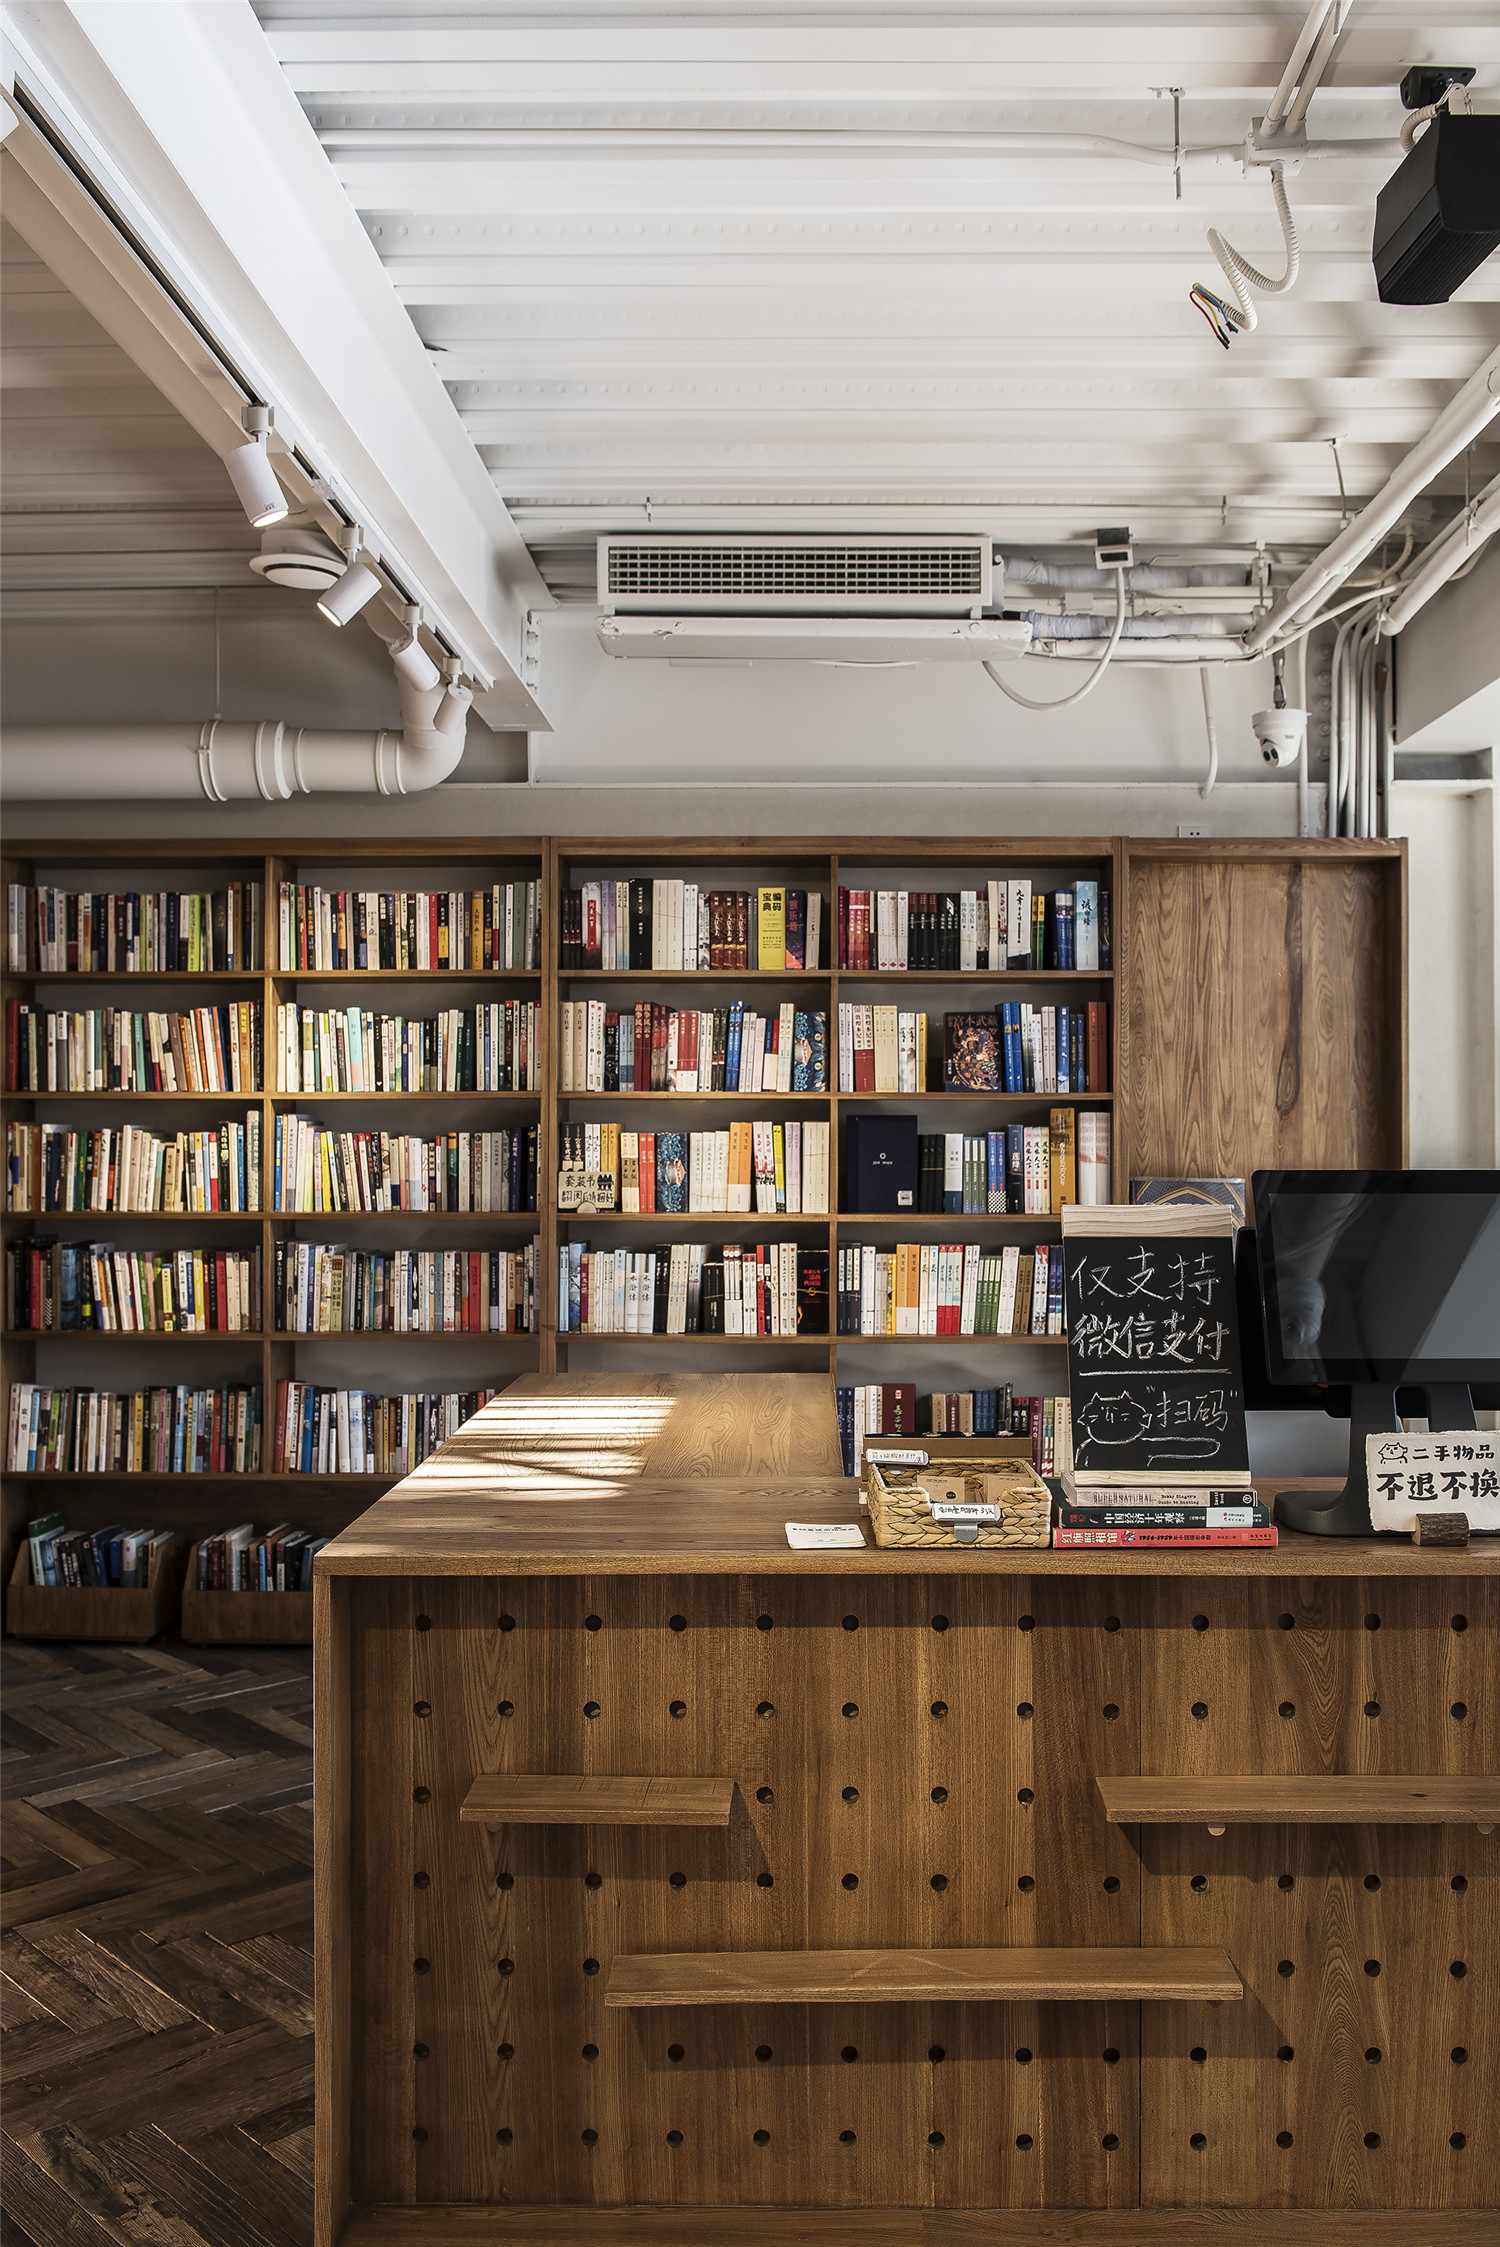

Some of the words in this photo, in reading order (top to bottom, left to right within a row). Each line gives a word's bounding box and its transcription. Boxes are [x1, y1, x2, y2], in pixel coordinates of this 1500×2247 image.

[566, 1174, 595, 1189] 套装书
[1071, 1244, 1220, 1305] 仅支持
[1071, 1310, 1230, 1363] 微信支付
[1412, 1444, 1495, 1461] 二手物品
[1376, 1468, 1500, 1501] 不退不换
[1104, 1512, 1185, 1524] 中国经济十年观察
[1061, 1532, 1118, 1544] 红旗照相馆
